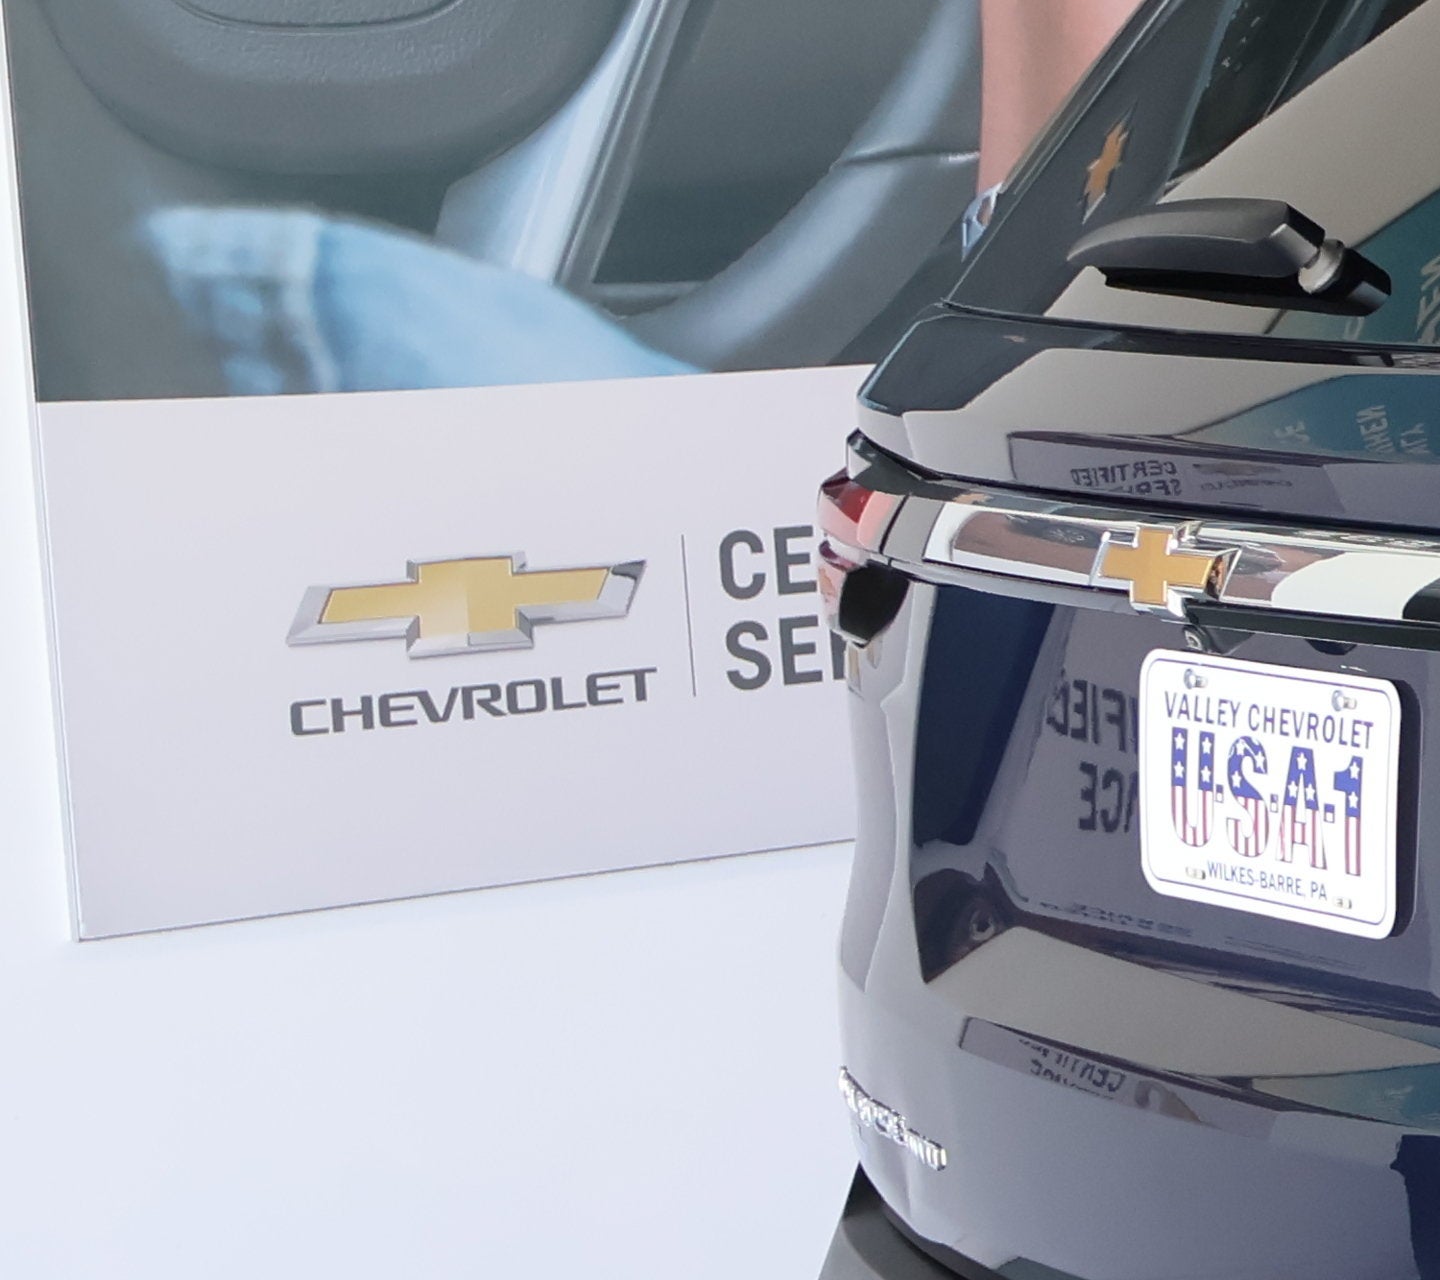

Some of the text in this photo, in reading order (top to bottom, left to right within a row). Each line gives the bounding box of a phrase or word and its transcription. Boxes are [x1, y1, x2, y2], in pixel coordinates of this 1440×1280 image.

[290, 666, 658, 738] CHEVROLET
[1164, 690, 1374, 750] VALLEY CHEVROLET
[1206, 859, 1328, 902] WILKES-BARRE, PA
